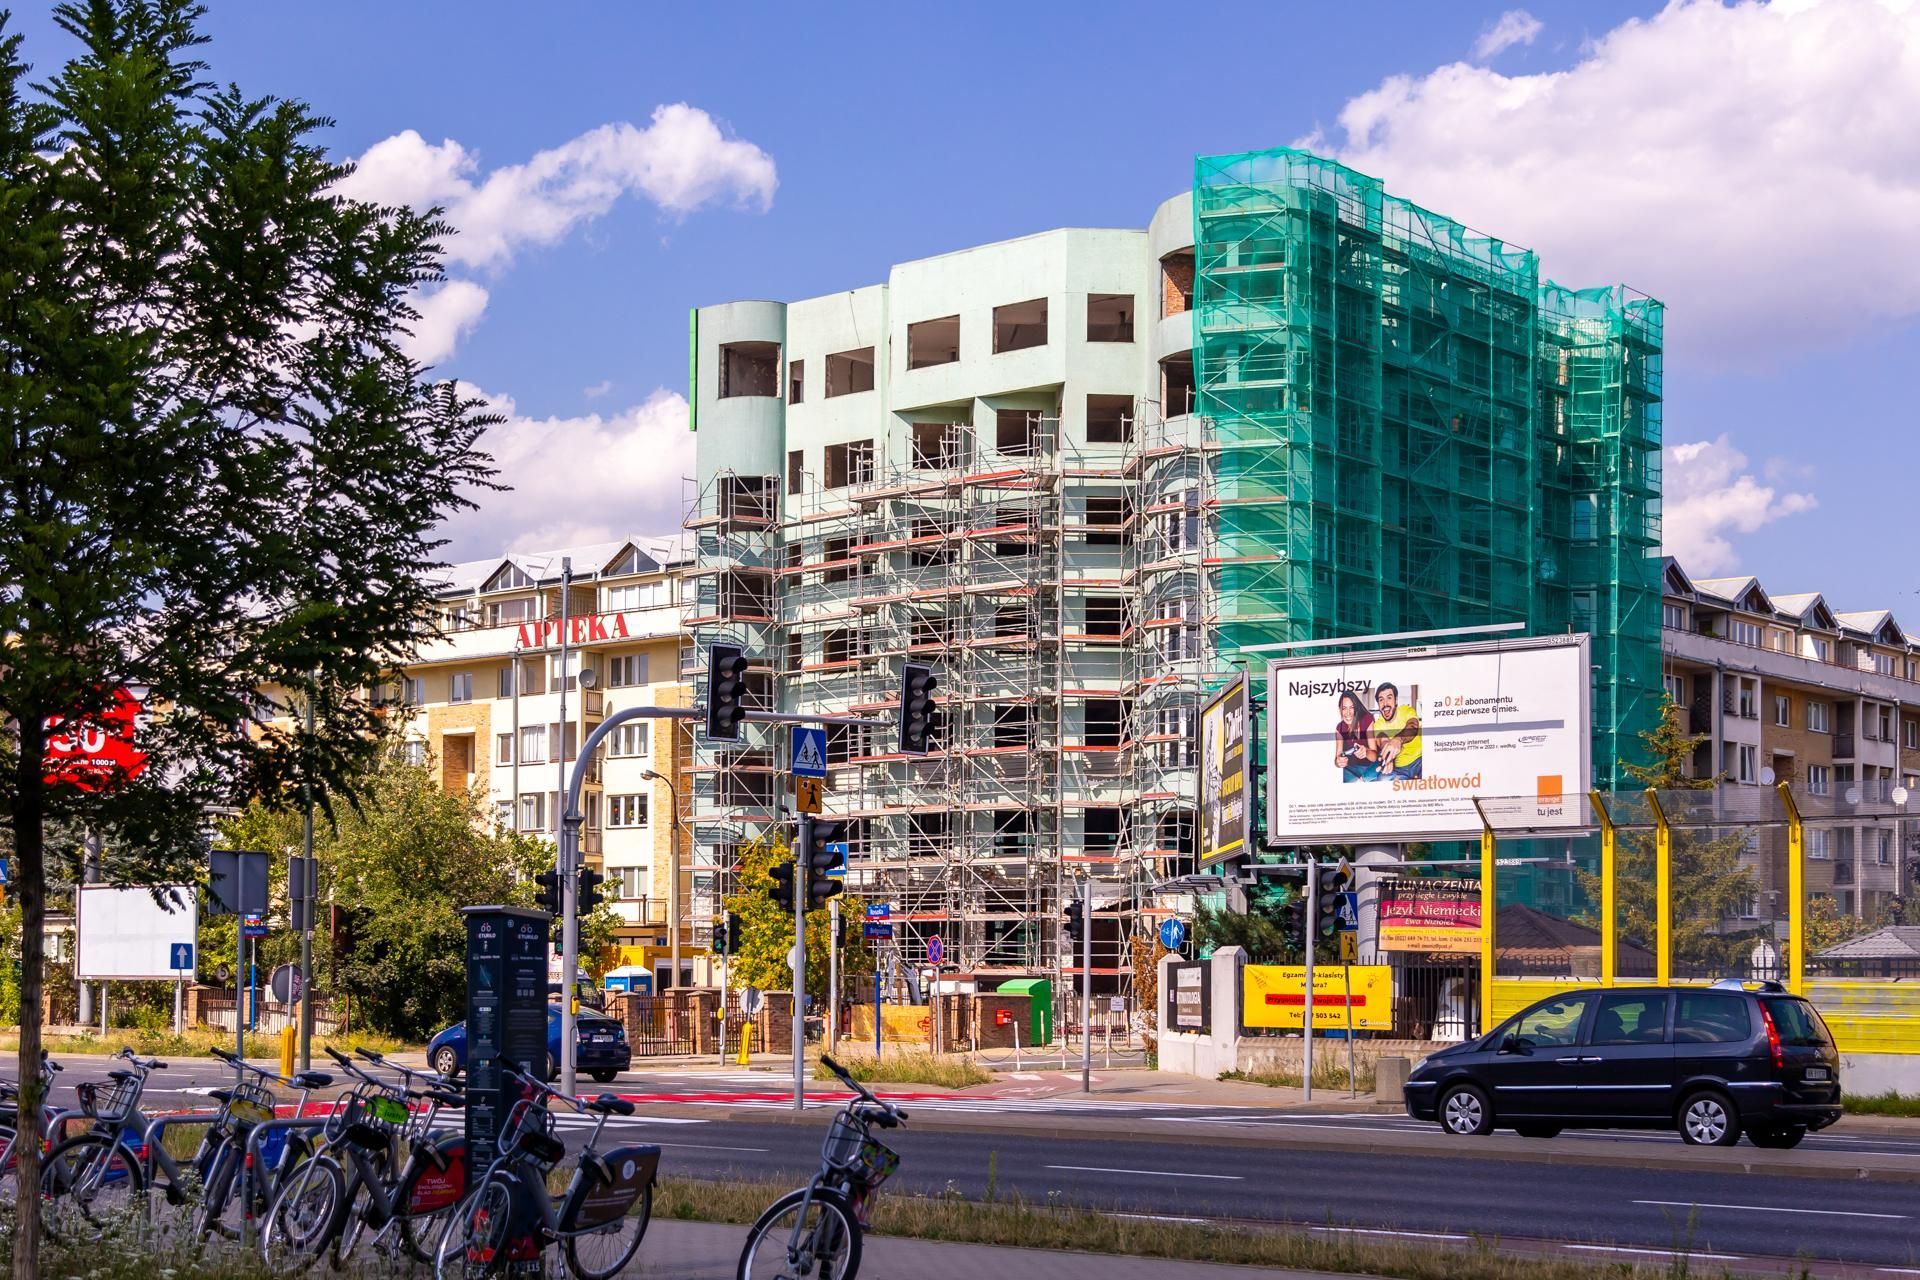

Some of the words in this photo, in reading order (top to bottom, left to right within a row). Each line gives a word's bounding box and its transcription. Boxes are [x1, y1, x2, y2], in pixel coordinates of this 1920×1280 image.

[515, 612, 630, 649] APTEKA
[1289, 679, 1371, 698] Najszybszy
[1444, 696, 1451, 706] 0
[1454, 695, 1464, 706] zł
[1465, 696, 1513, 706] abonamentu
[1434, 708, 1455, 717] przez
[1456, 706, 1490, 716] pierwsze
[1498, 704, 1520, 713] mies.
[1537, 808, 1545, 816] tu
[1547, 807, 1562, 817] jest
[1419, 904, 1482, 917] Niemiecki
